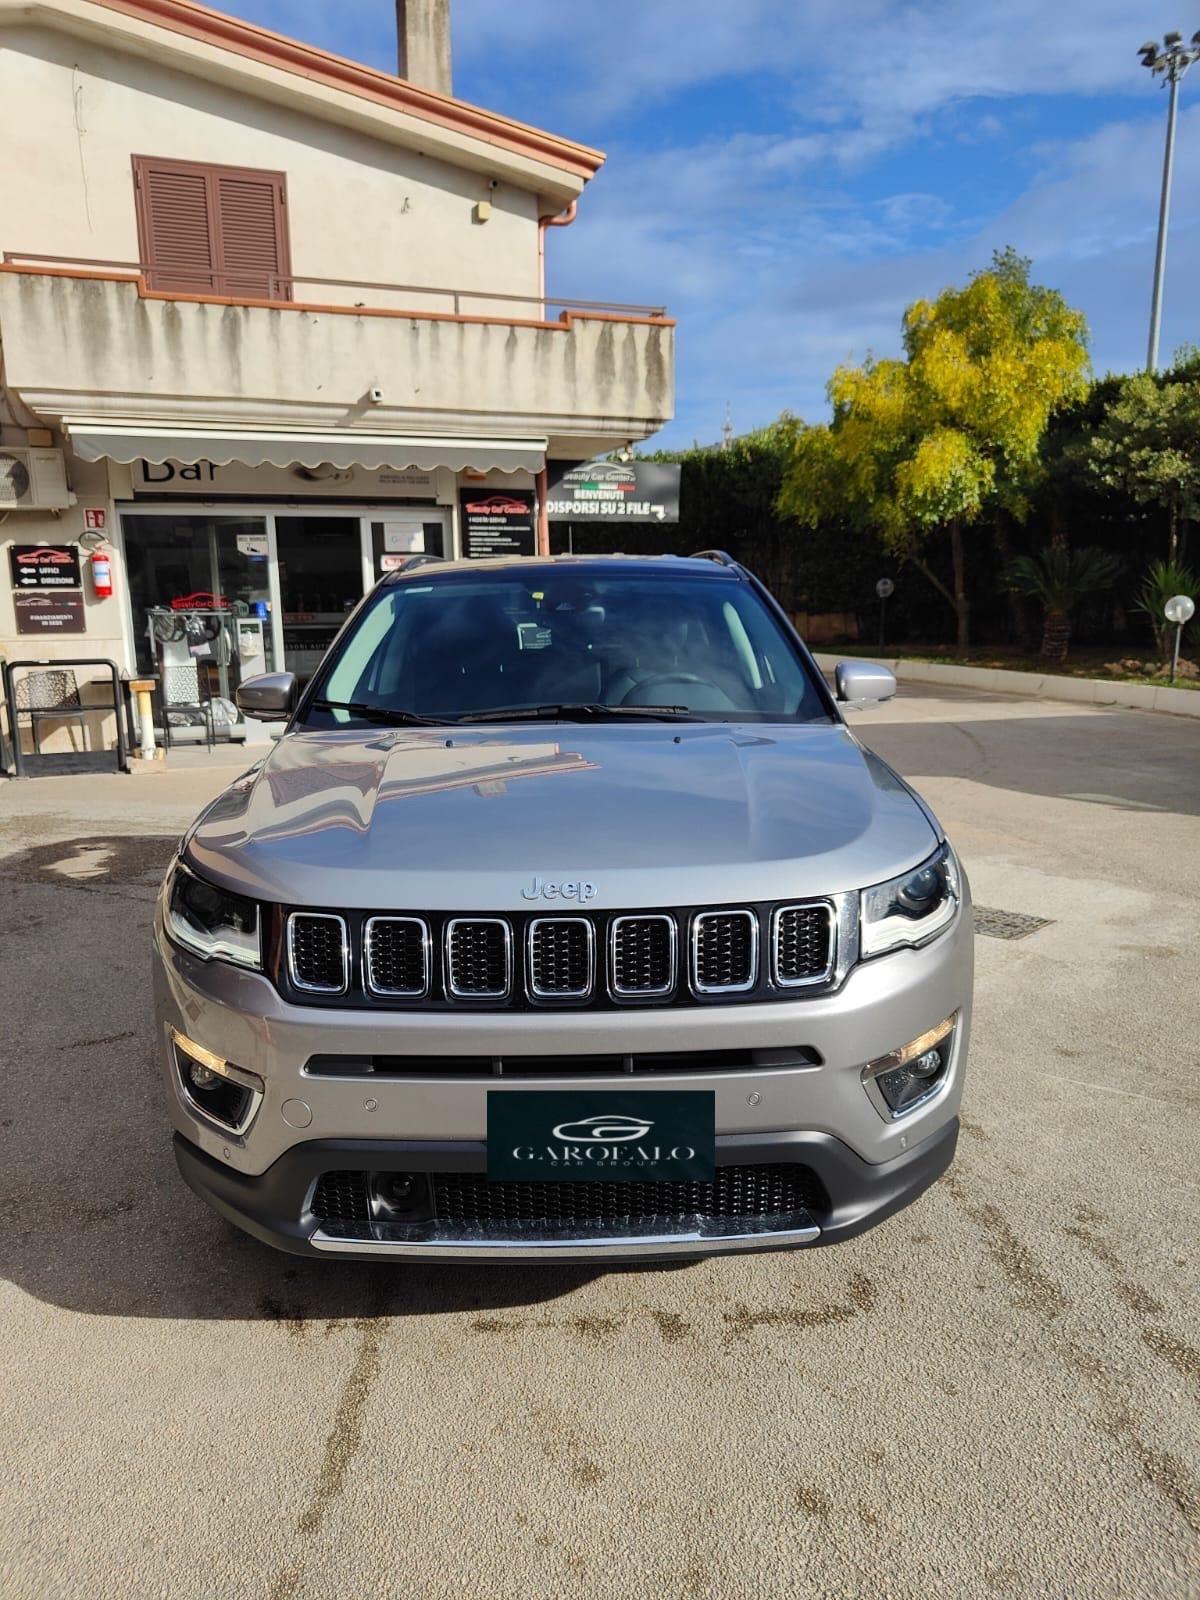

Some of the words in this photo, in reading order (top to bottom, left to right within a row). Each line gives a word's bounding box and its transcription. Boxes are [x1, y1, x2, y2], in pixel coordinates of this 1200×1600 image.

[574, 490, 624, 500] BENVENUTI
[546, 501, 600, 514] DISPORSI
[600, 502, 617, 514] SU
[617, 502, 626, 514] 2
[627, 502, 650, 515] FILE
[521, 876, 598, 904] Jeep
